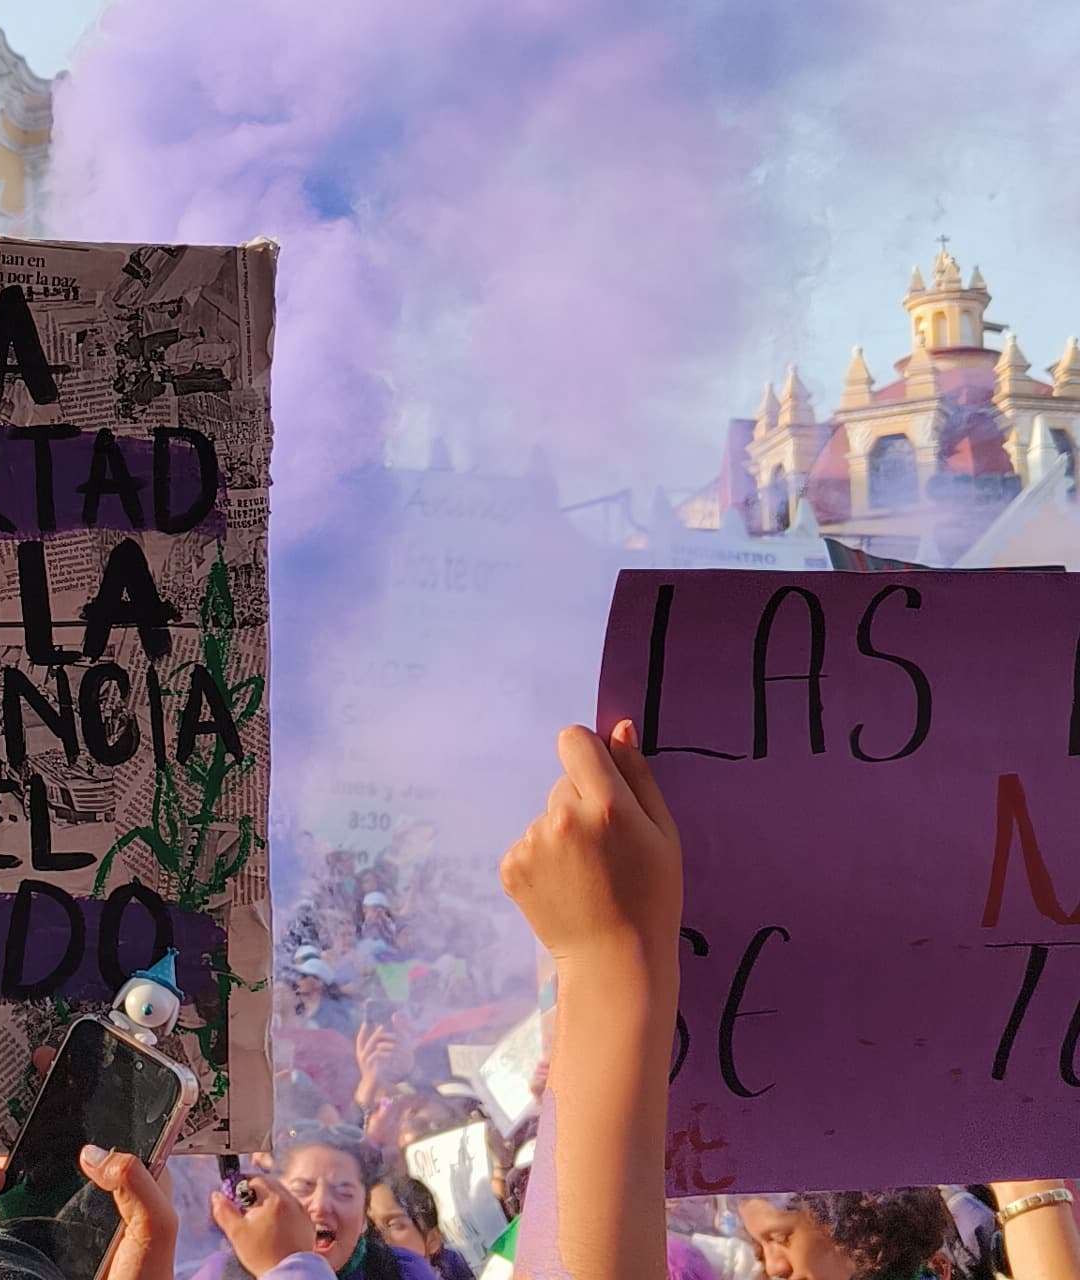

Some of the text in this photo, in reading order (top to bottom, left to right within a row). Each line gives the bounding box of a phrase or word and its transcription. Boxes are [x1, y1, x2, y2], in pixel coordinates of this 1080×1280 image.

[7, 272, 33, 284] por
[36, 271, 47, 285] la
[27, 256, 45, 268] en
[19, 538, 182, 665] LA
[641, 584, 933, 762] LAS
[348, 810, 391, 831] 8:30
[985, 941, 1080, 1089] T
